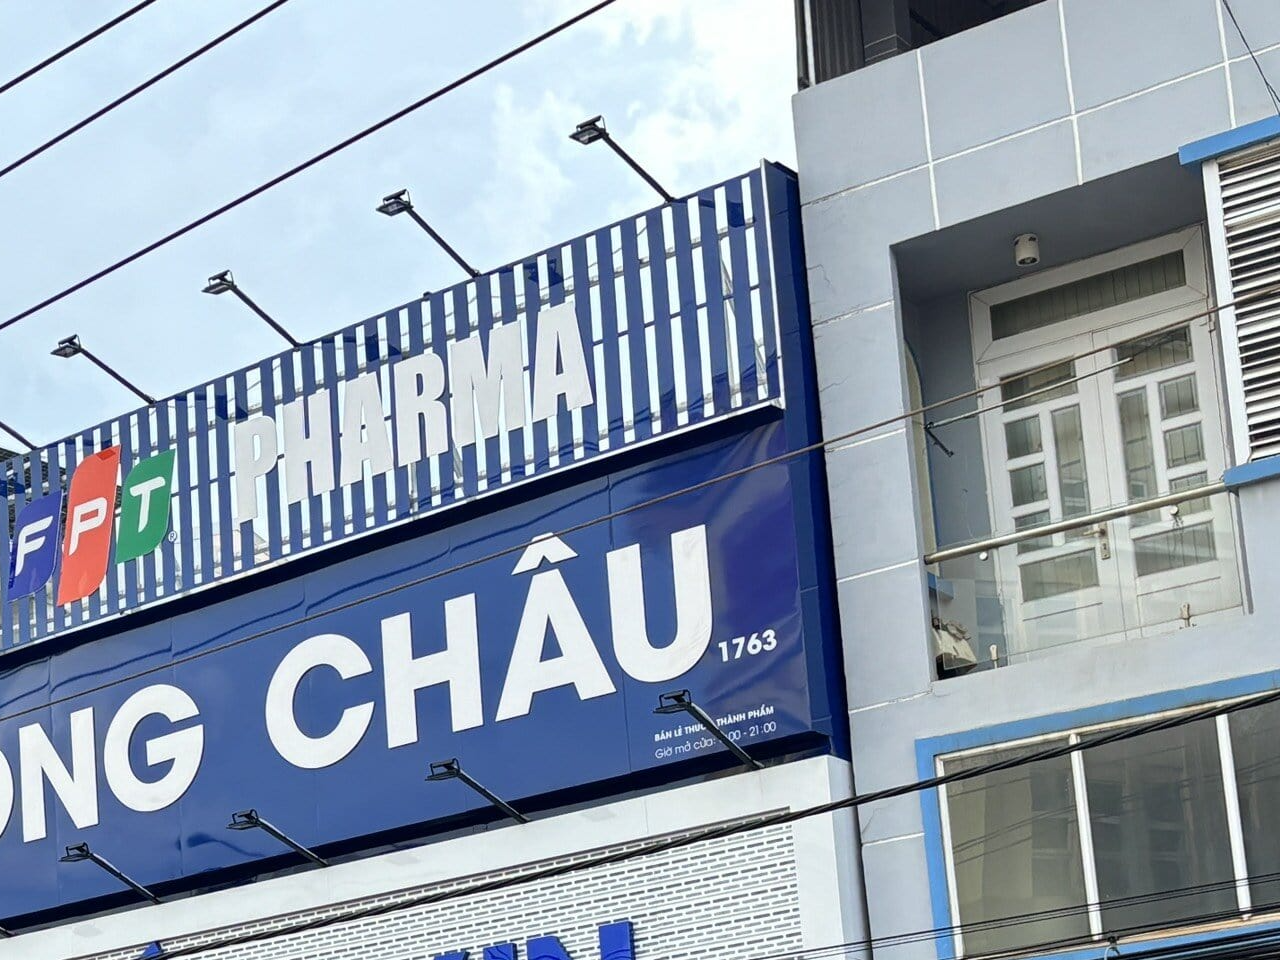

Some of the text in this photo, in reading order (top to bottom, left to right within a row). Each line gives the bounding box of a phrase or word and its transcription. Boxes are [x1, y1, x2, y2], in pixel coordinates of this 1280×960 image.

[12, 303, 594, 584] FPT PHARMA
[266, 524, 714, 770] CHÂU
[718, 628, 778, 664] 1763
[654, 730, 672, 743] BÁN
[716, 713, 746, 727] THÀNH
[748, 704, 774, 720] PHẨM
[655, 721, 777, 760] Giờ mở cửa: 21:00
